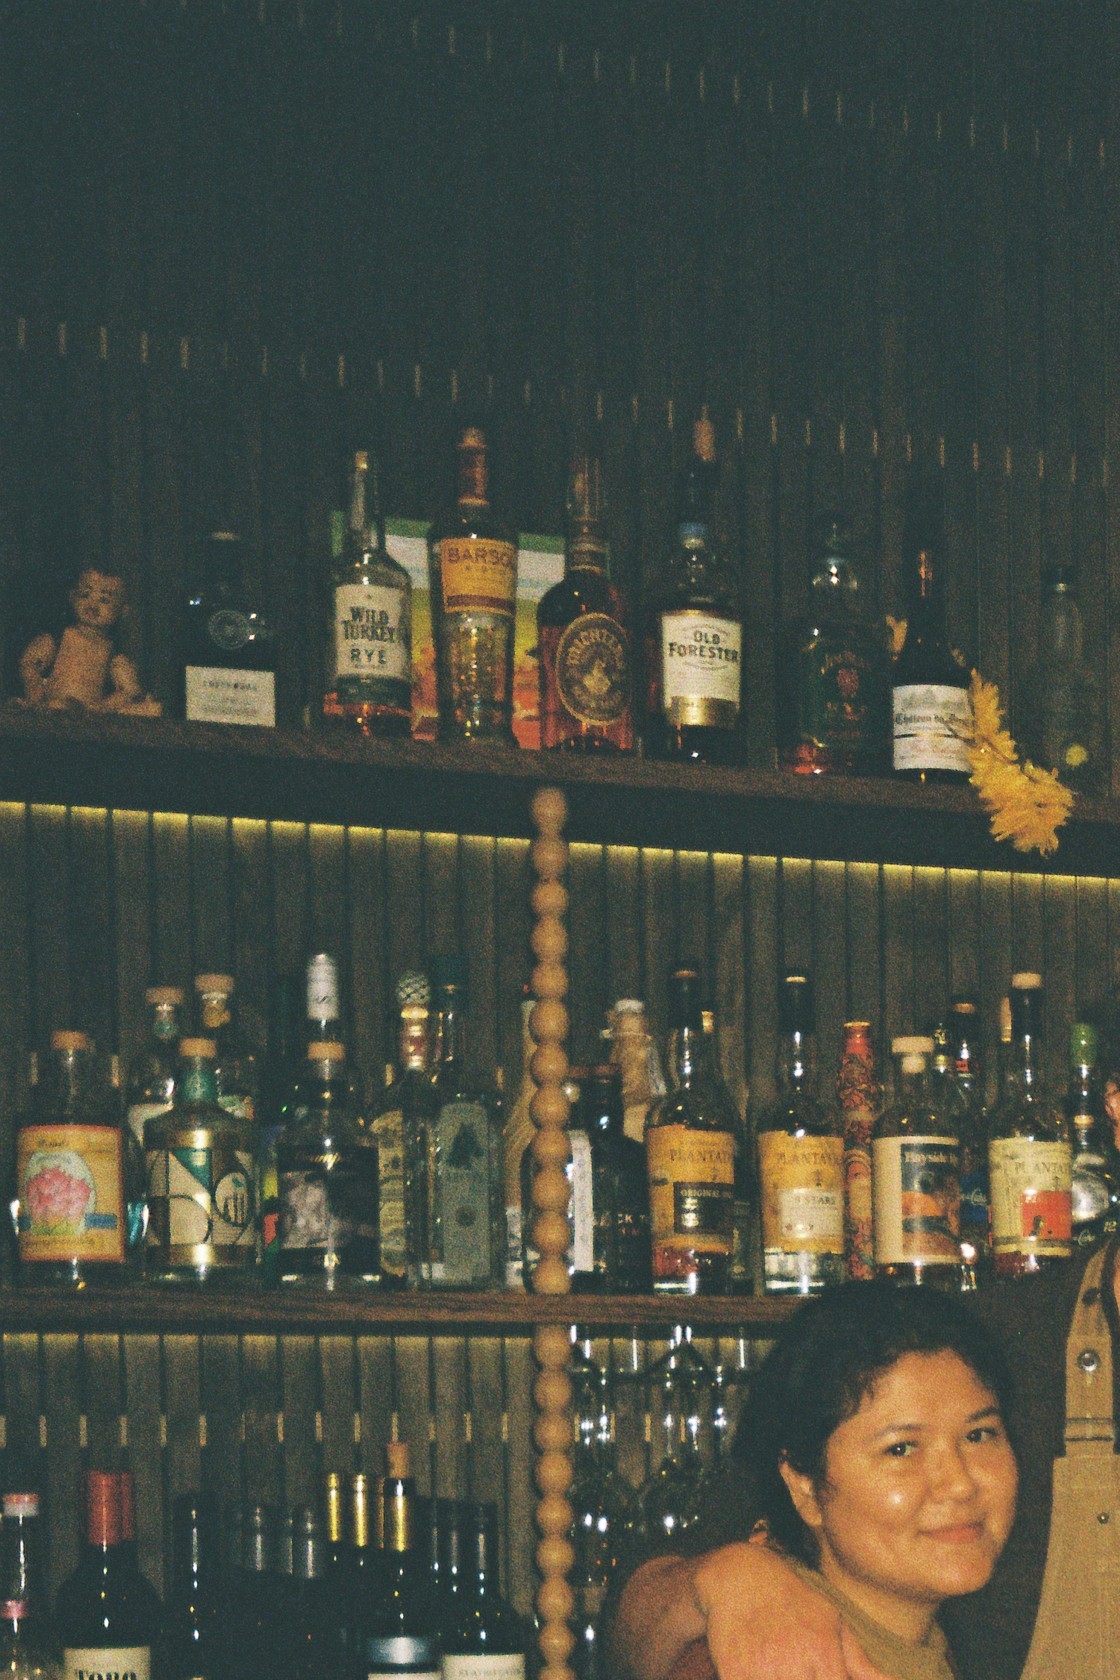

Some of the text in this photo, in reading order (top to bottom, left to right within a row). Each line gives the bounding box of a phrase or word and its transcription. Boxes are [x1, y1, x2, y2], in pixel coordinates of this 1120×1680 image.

[350, 606, 389, 625] WILD
[342, 619, 398, 644] TURKEY
[694, 630, 720, 645] OLD
[350, 648, 387, 664] RYE
[668, 641, 738, 661] FORESTER
